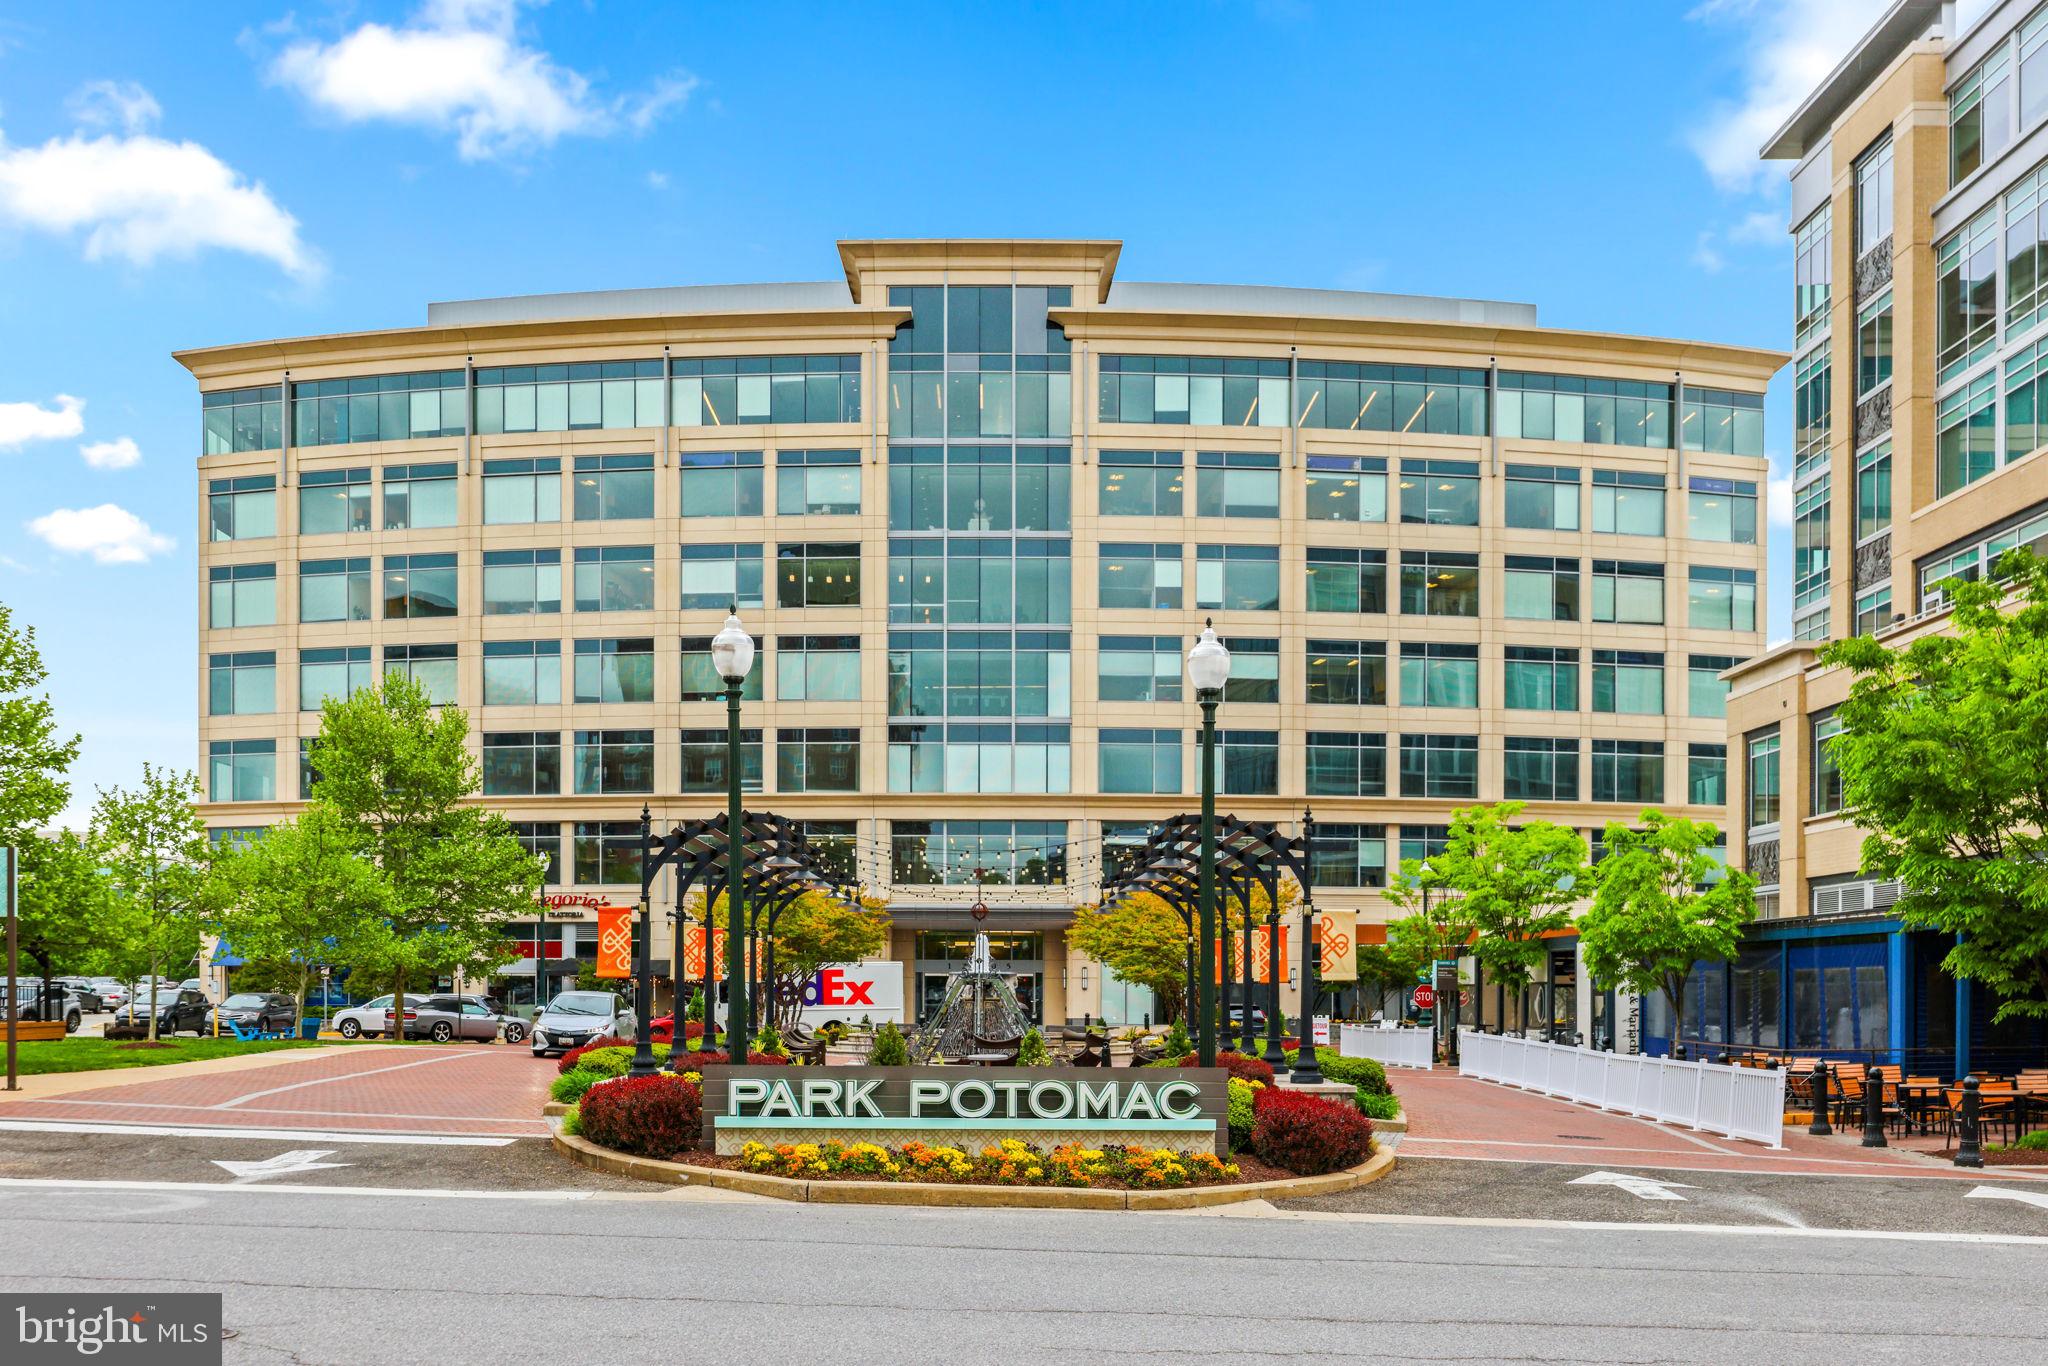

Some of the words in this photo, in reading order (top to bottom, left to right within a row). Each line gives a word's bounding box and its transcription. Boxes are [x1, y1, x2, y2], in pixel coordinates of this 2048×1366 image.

[1415, 991, 1434, 1001] STO
[728, 1078, 885, 1118] PARK
[910, 1079, 1202, 1119] POTOMAC
